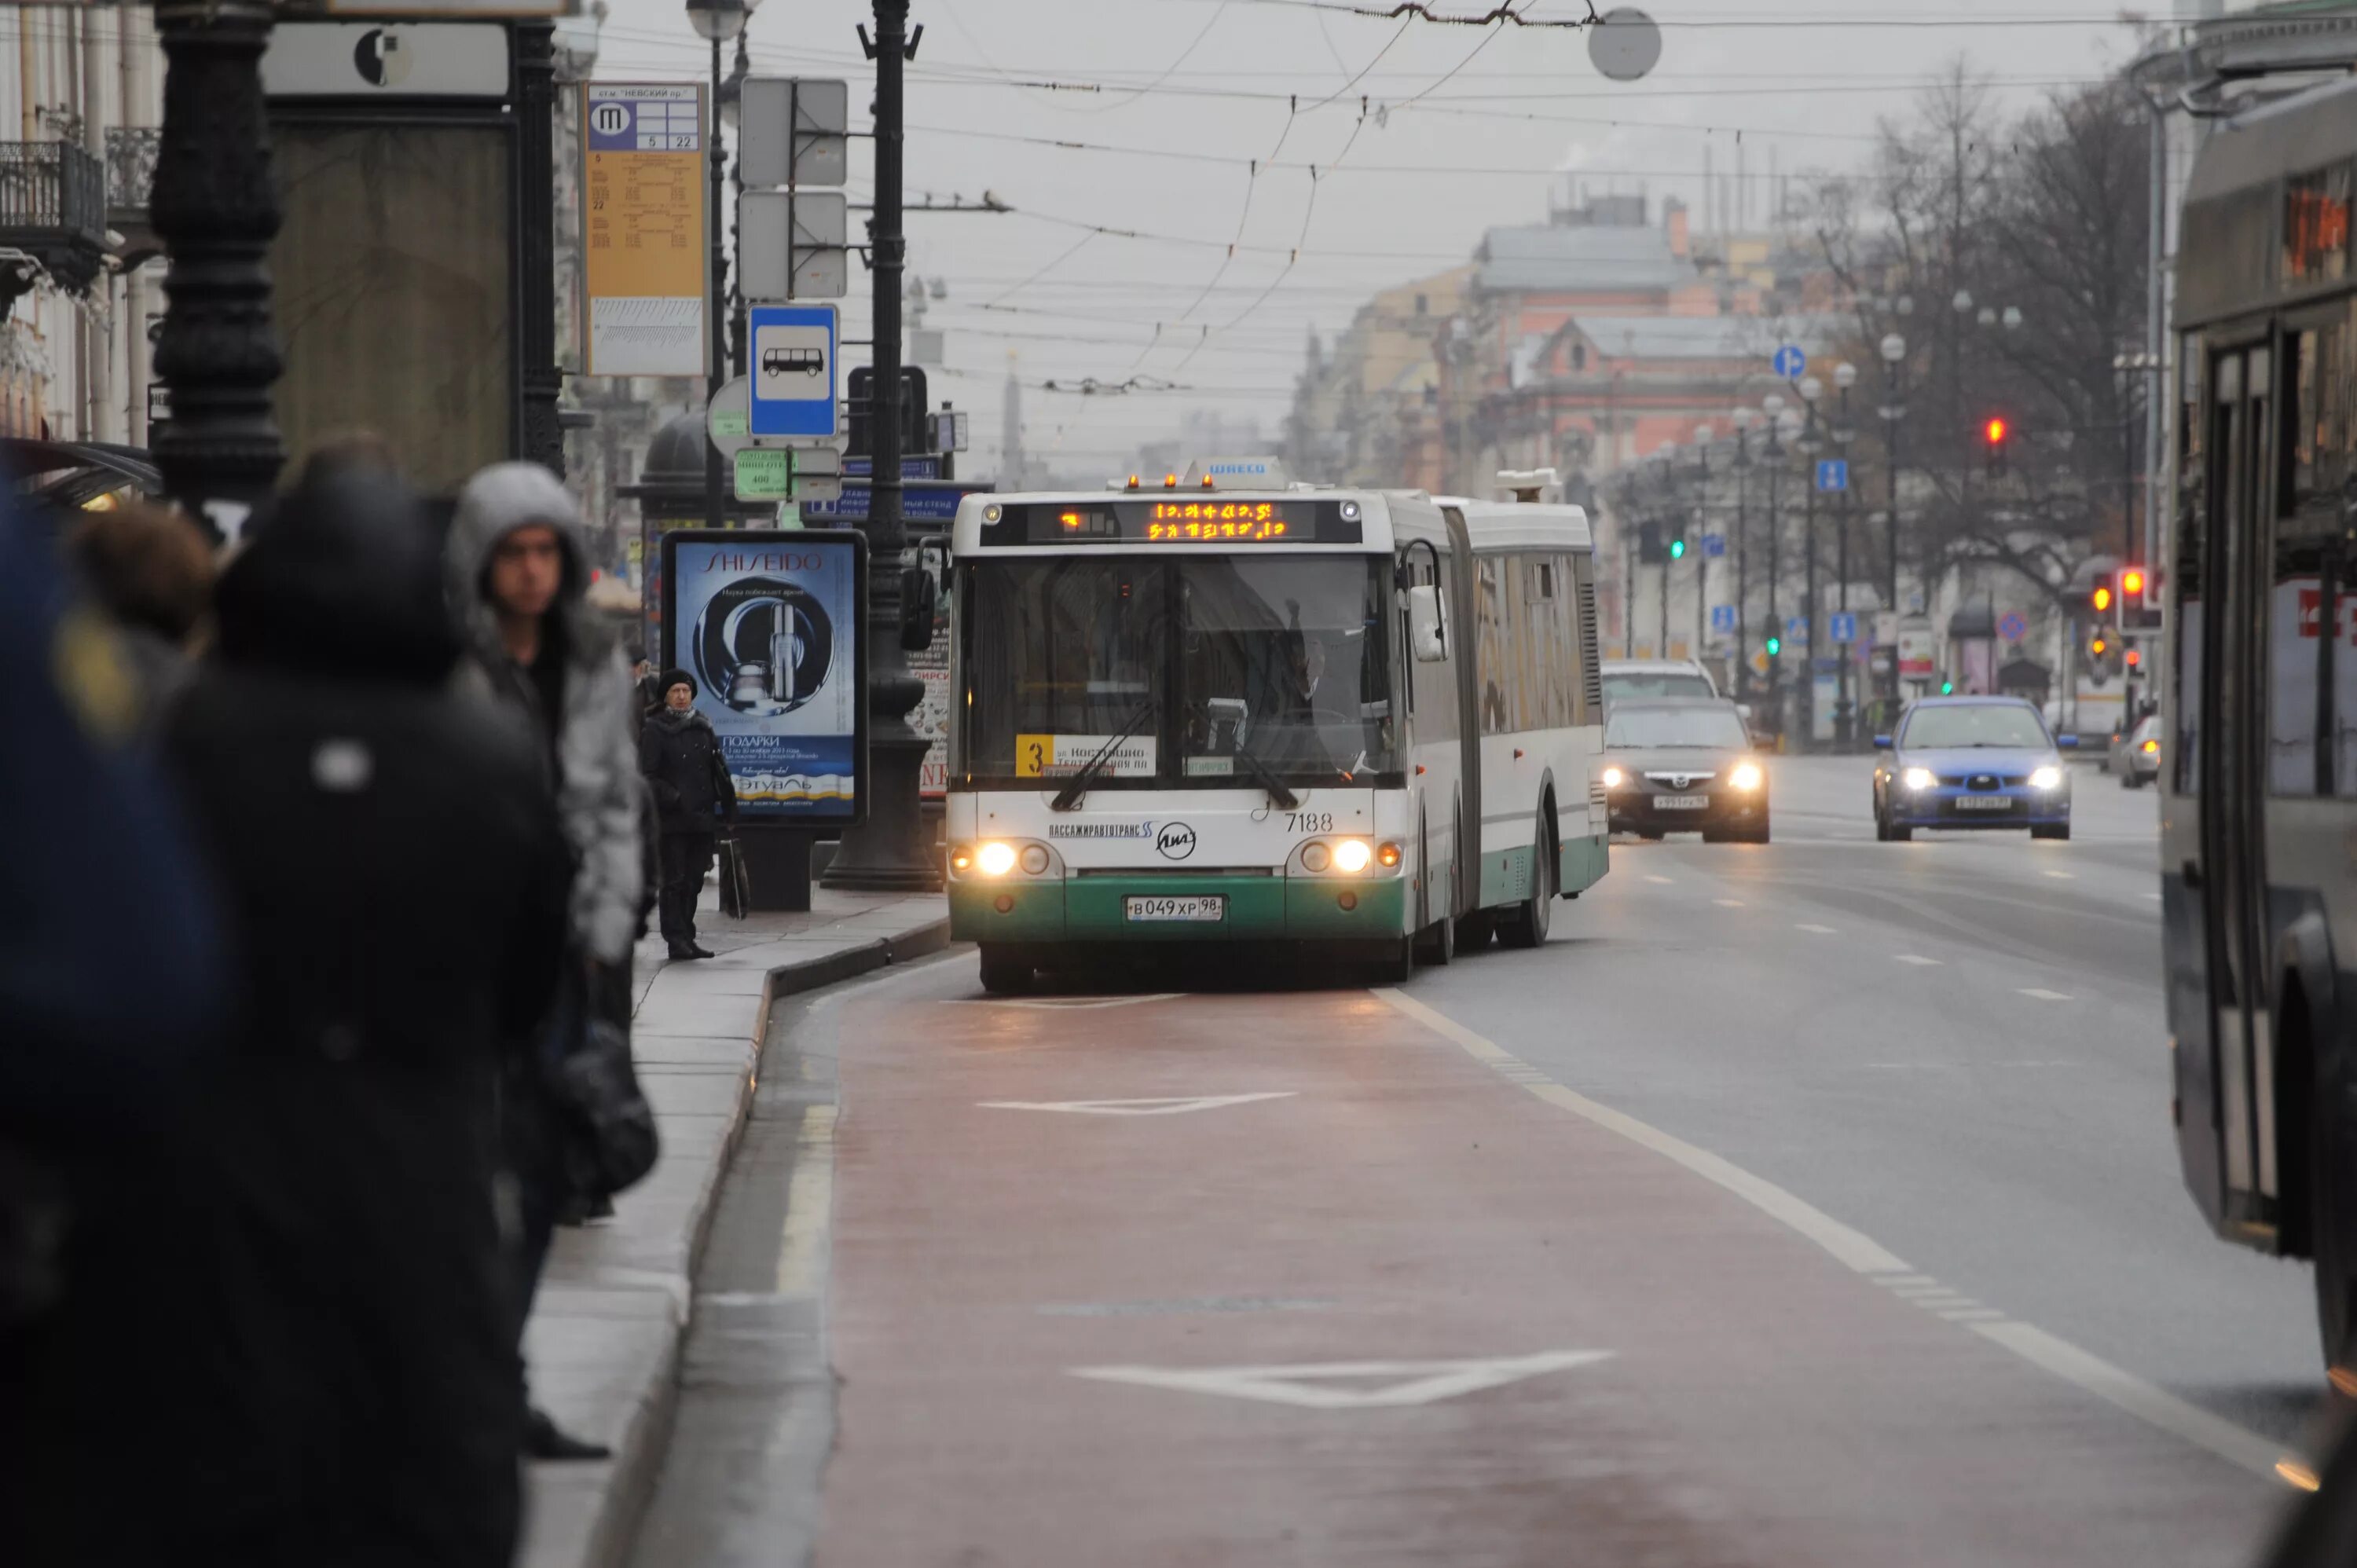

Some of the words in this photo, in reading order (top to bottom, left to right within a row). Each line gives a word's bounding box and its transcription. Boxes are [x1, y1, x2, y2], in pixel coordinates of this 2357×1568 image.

[648, 136, 656, 148] 5
[676, 136, 691, 148] 22
[703, 551, 822, 573] SHISEIDO
[722, 735, 780, 747] ПОДАРКИ
[1028, 742, 1043, 774] 3
[1284, 812, 1334, 833] 7188
[1049, 824, 1141, 837] ПАССАЖИРАВТОТРАНС
[1201, 899, 1217, 911] 98
